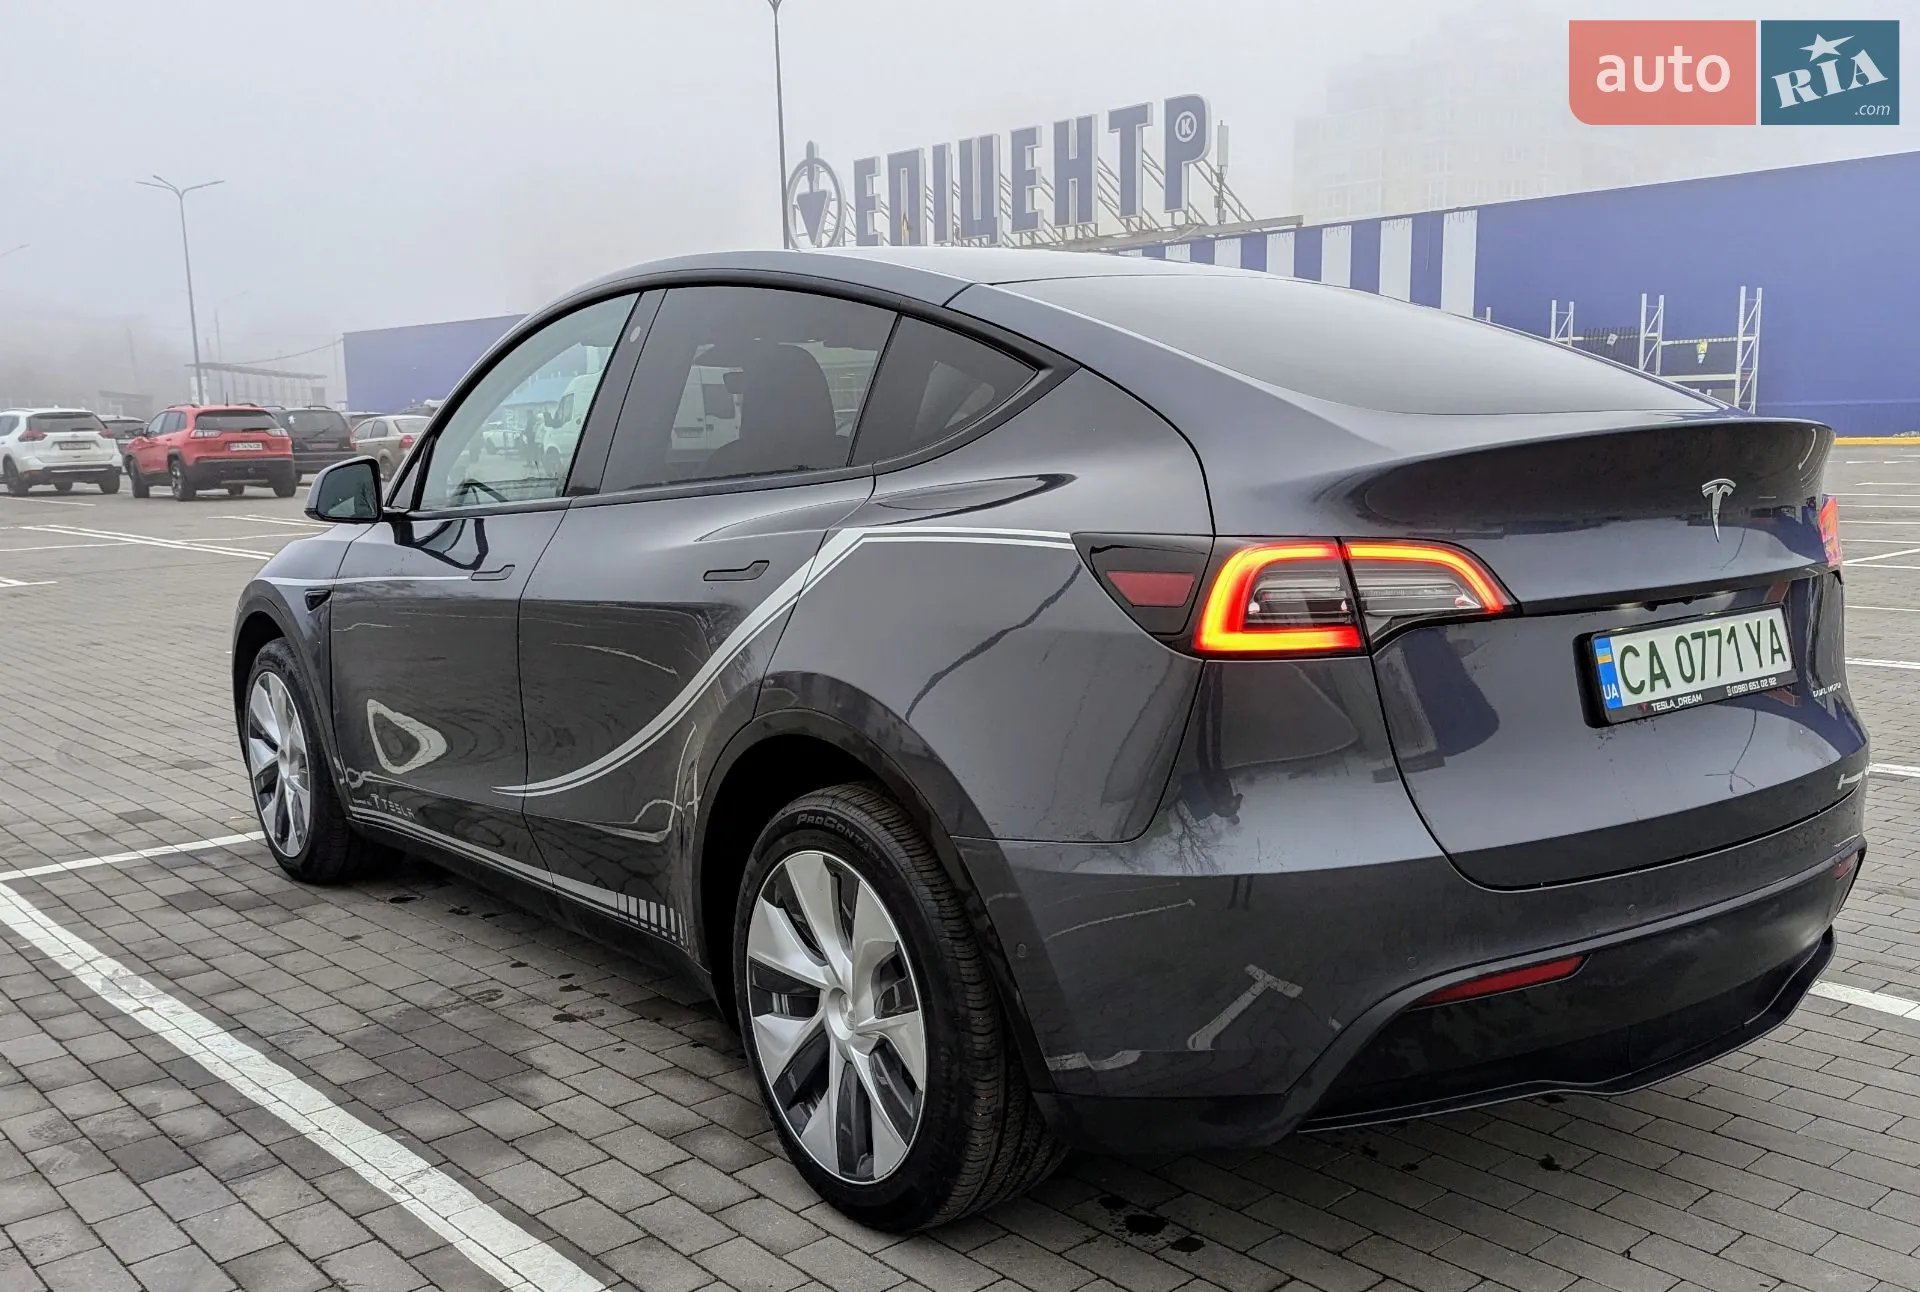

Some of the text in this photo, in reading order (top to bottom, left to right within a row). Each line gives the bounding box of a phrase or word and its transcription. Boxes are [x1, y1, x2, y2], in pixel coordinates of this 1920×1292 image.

[853, 93, 1211, 247] ЕПІЦЕНТР
[1619, 617, 1787, 695] CA 0771 YA
[1603, 685, 1618, 700] UA
[1651, 693, 1703, 712] TESLA_DREAM
